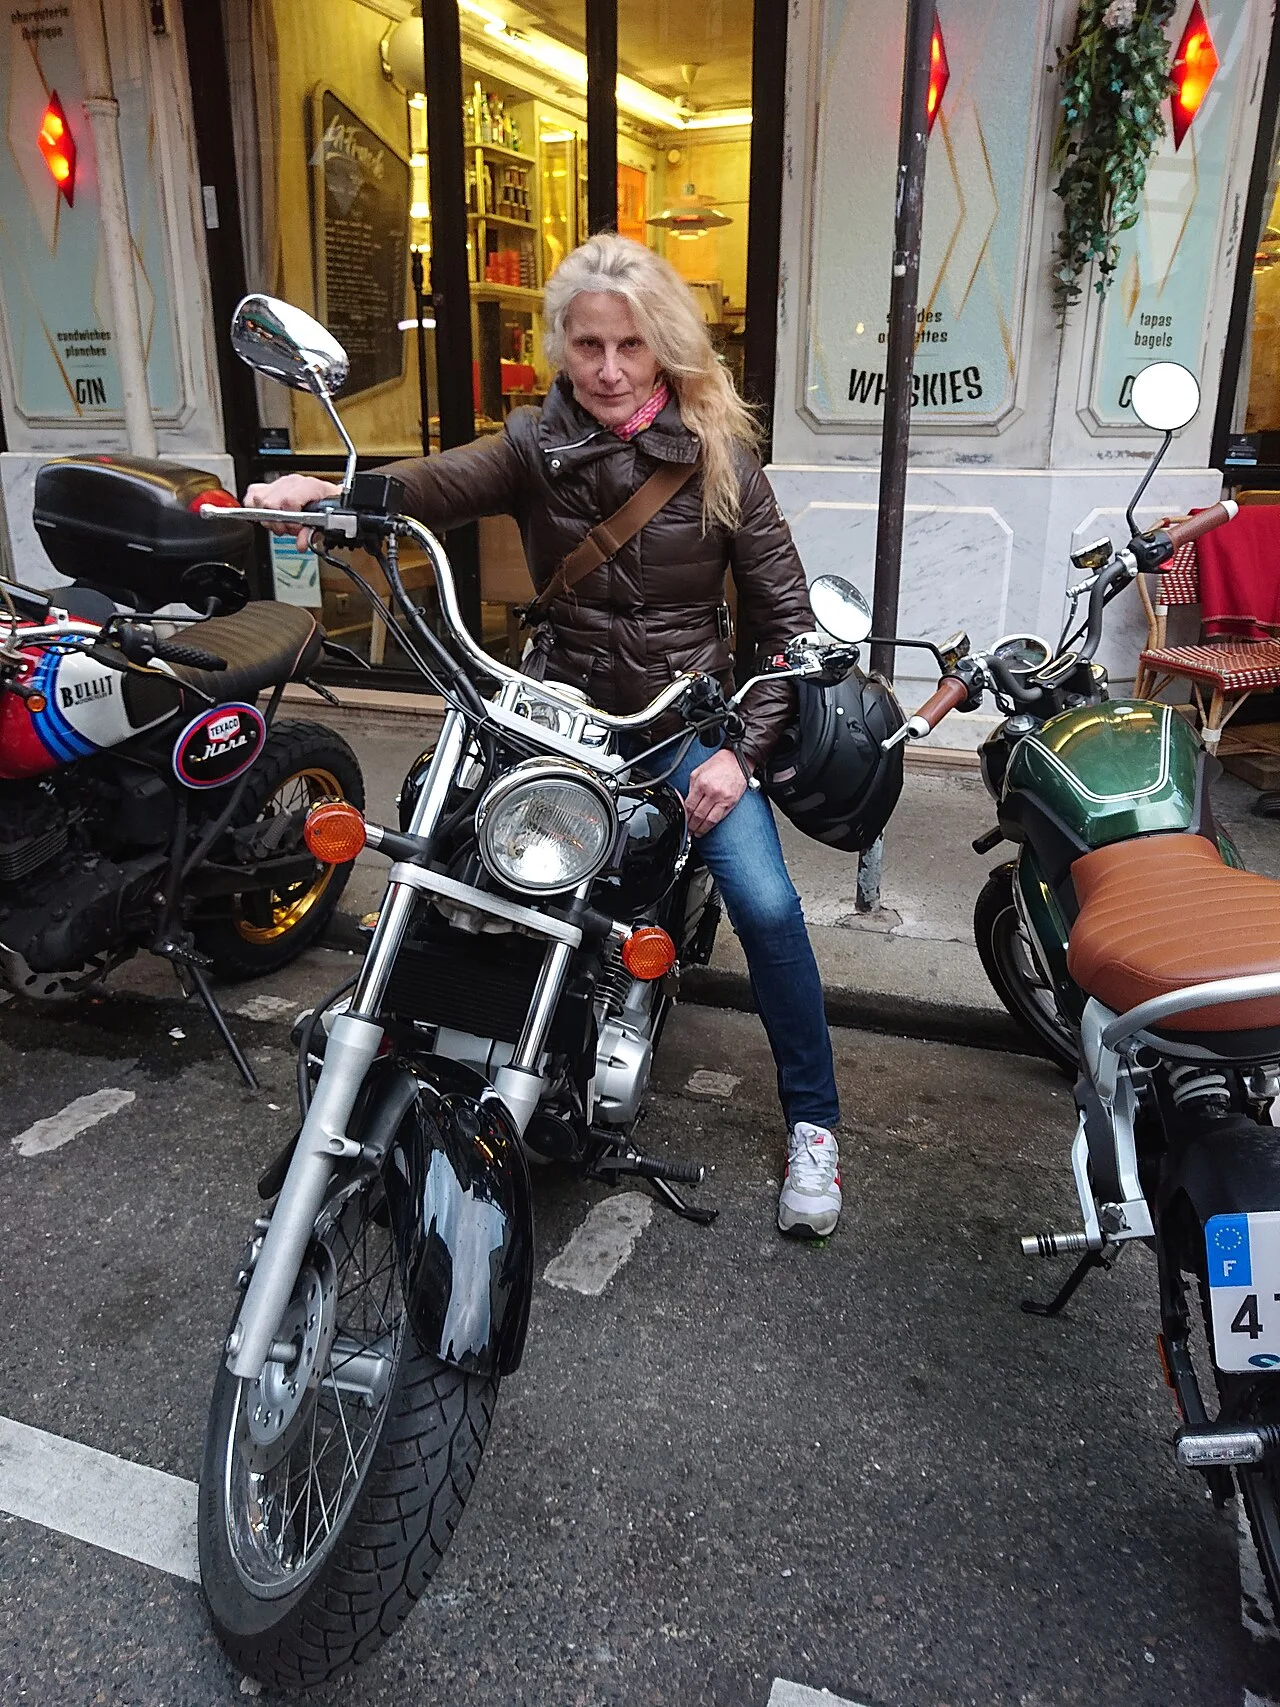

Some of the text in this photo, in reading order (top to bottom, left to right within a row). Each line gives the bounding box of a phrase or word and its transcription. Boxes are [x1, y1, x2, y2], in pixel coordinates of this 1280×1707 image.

[1140, 312, 1172, 329] tapas
[57, 329, 111, 341] sandwiches
[1134, 331, 1173, 349] bagels
[65, 344, 107, 359] planches
[76, 377, 107, 405] GIN
[848, 366, 983, 407] WHSKIES
[60, 675, 112, 708] BULLIT
[211, 718, 239, 737] TEXACO
[202, 735, 248, 761] Hero
[1223, 1260, 1237, 1277] F
[1231, 1293, 1280, 1340] 4
